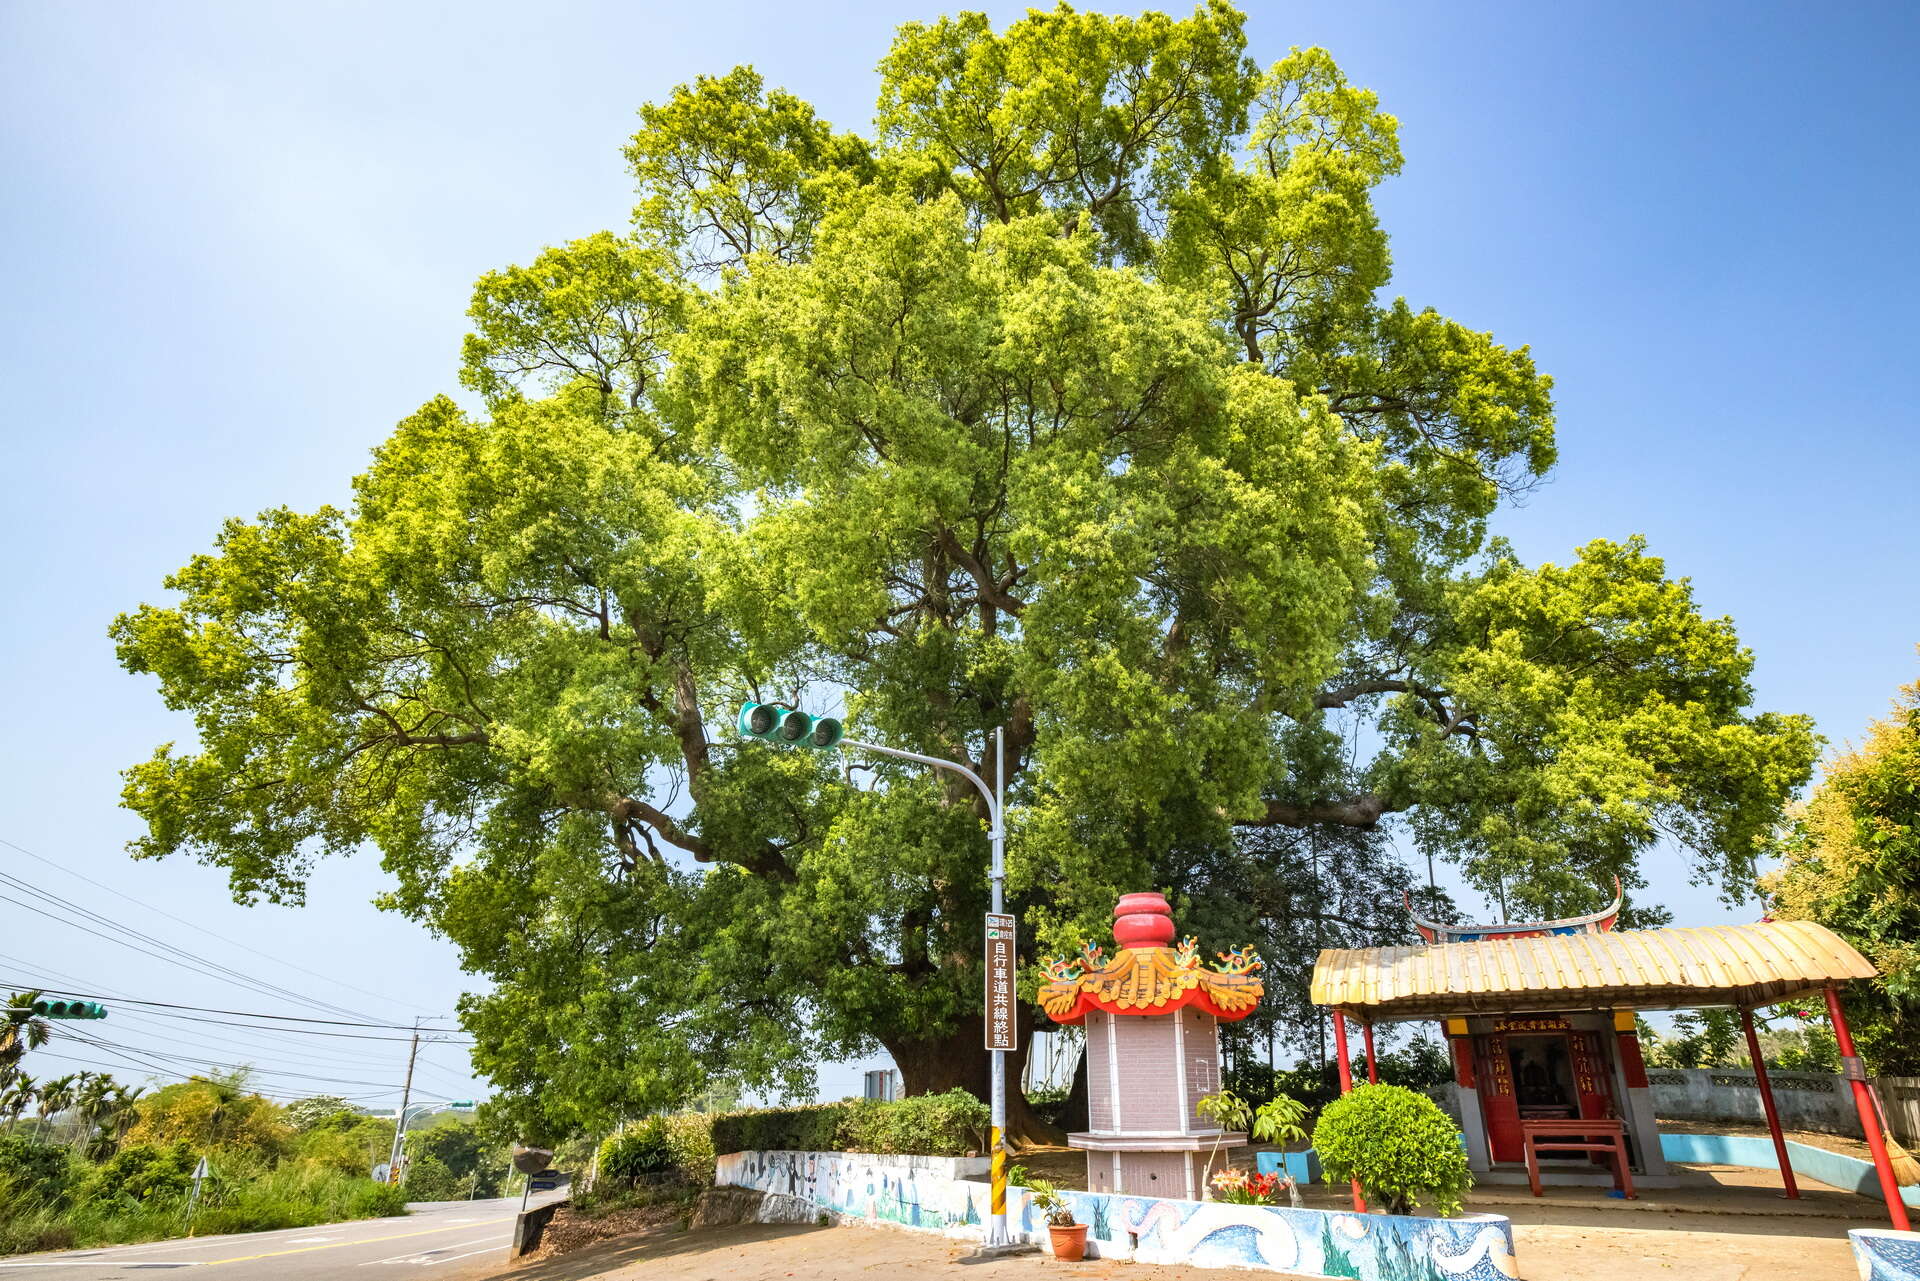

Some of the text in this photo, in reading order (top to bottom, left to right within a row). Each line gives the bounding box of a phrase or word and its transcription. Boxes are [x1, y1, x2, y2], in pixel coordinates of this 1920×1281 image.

[993, 942, 1009, 1047] 自行車道共線終點
